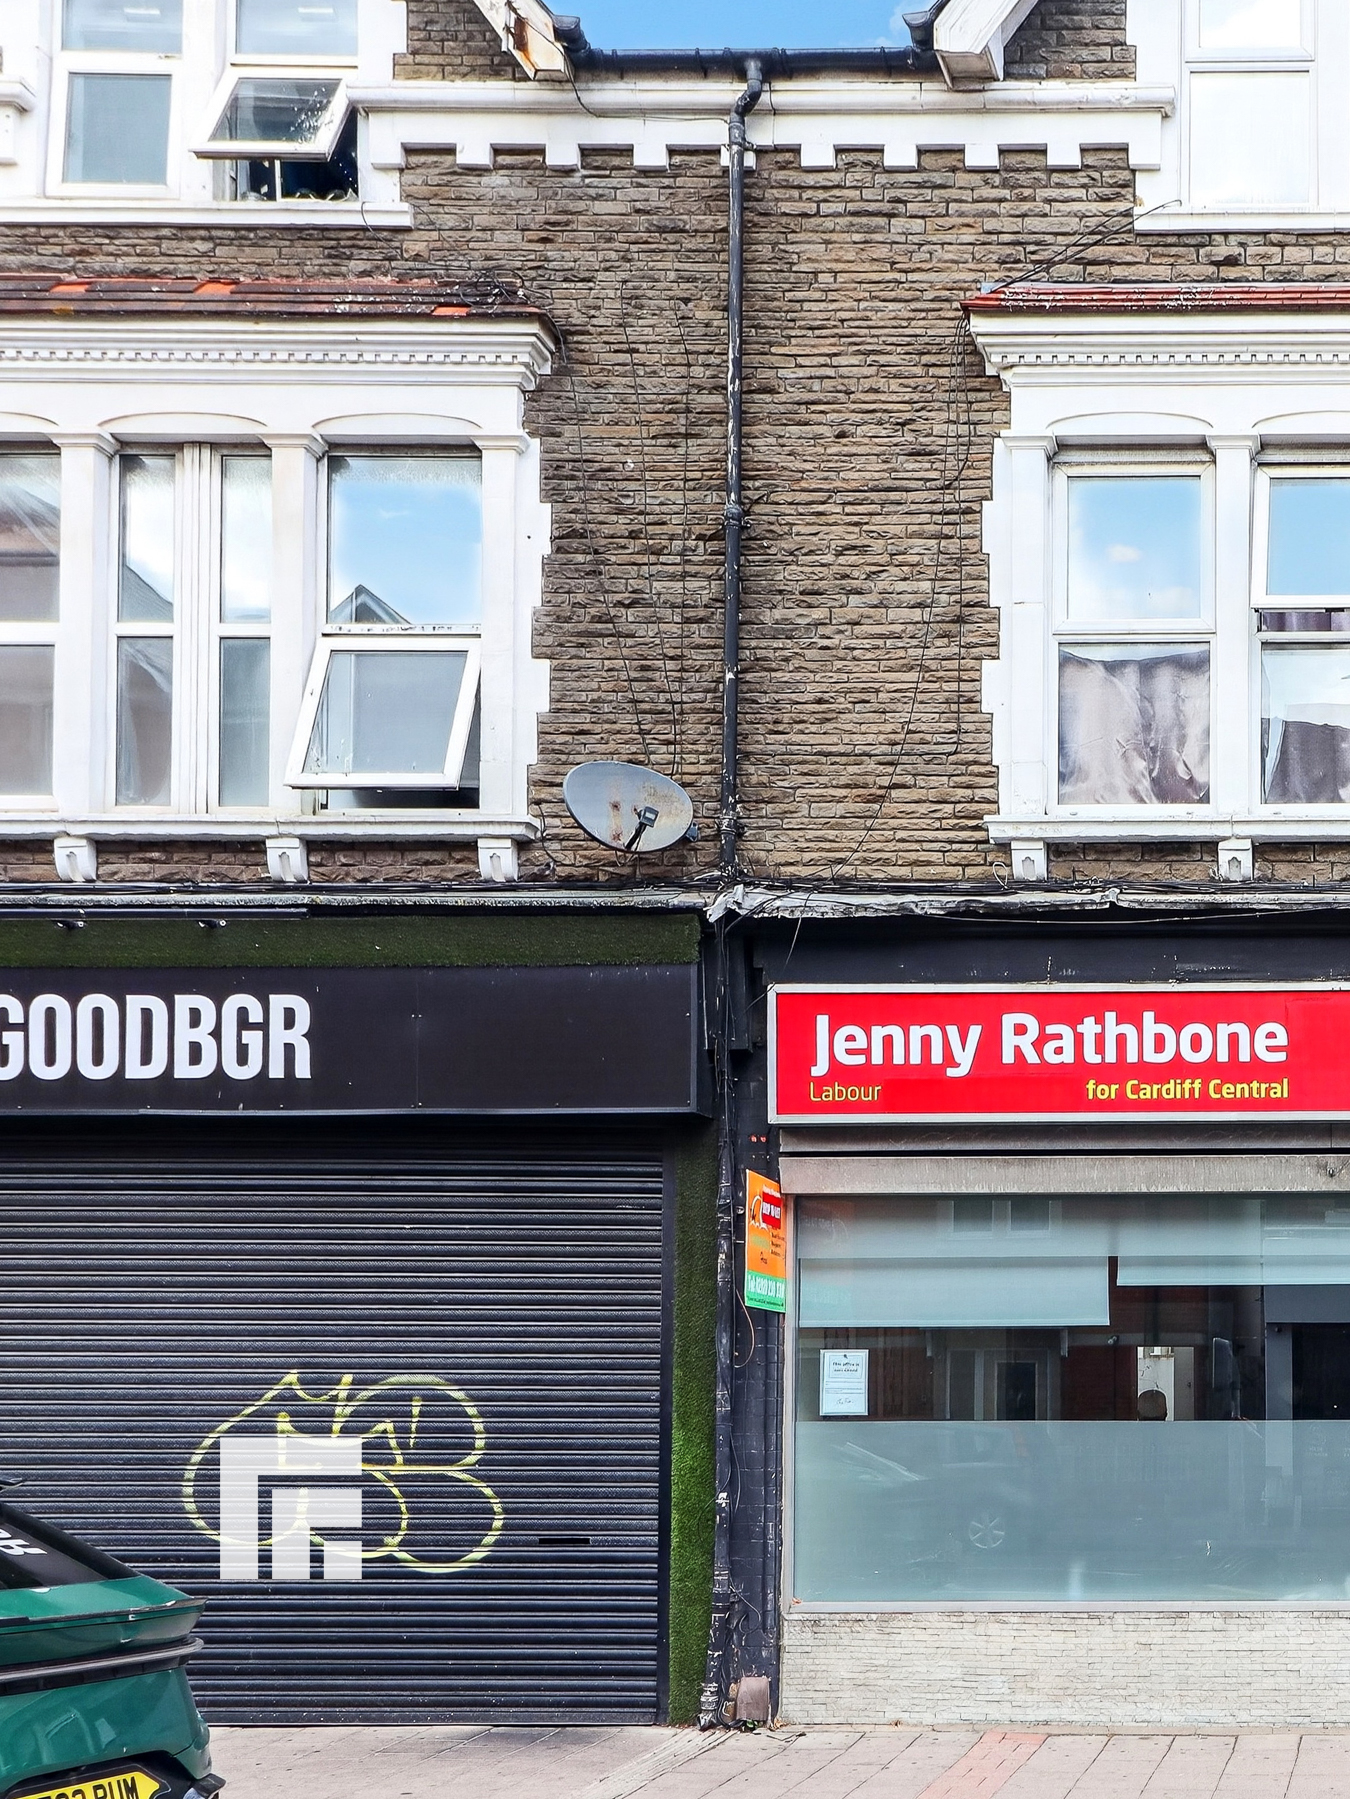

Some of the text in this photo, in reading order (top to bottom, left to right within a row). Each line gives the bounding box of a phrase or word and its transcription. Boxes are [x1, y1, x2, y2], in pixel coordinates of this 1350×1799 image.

[0, 993, 312, 1080] GOODBGR
[810, 1010, 1289, 1078] Jenny Rathbone
[809, 1081, 882, 1102] Labour
[1086, 1077, 1290, 1099] for Cardiff Central
